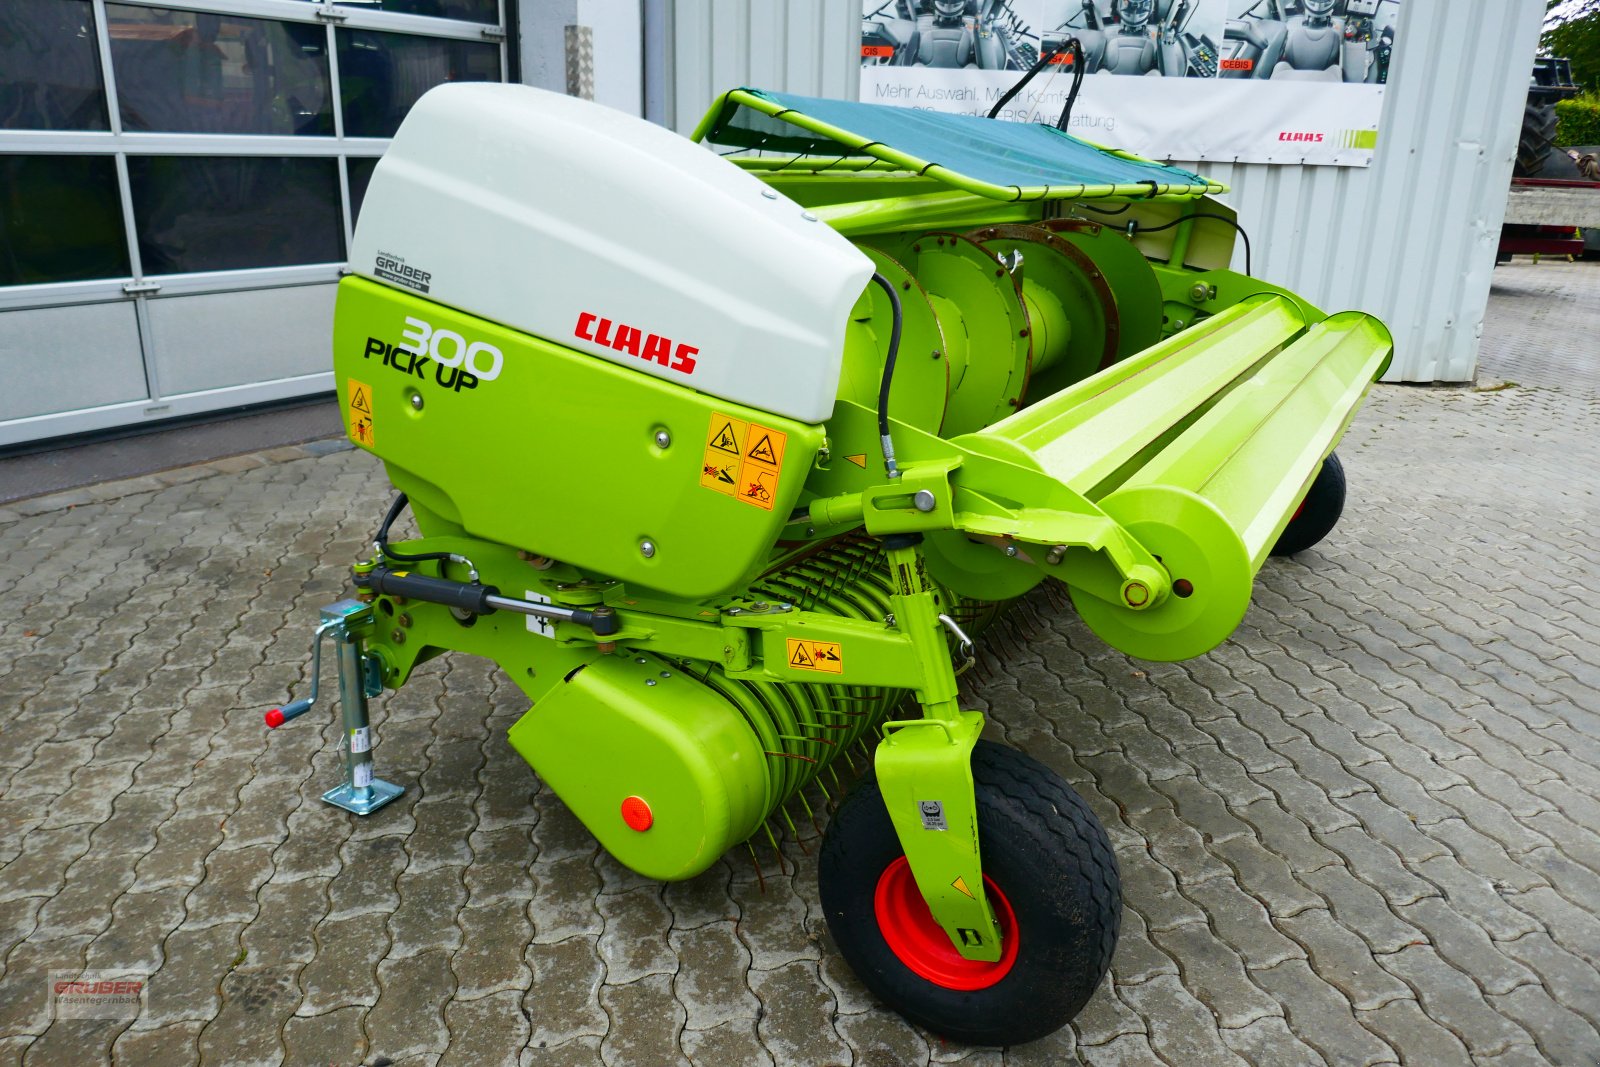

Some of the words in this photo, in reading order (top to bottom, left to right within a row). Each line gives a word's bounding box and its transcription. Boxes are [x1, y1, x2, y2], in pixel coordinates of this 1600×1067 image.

[863, 47, 878, 56] CIS
[1222, 60, 1249, 69] CEBIS
[875, 83, 912, 99] Mehr
[916, 84, 980, 101] Auswahl.
[985, 87, 1022, 102] Mer
[1027, 88, 1085, 105] Komfot.
[1278, 132, 1324, 142] CLAAS
[375, 256, 432, 284] GRUBER
[398, 315, 504, 382] 300
[574, 311, 700, 375] CLAAS
[363, 336, 431, 380] PICK
[435, 362, 479, 393] UP
